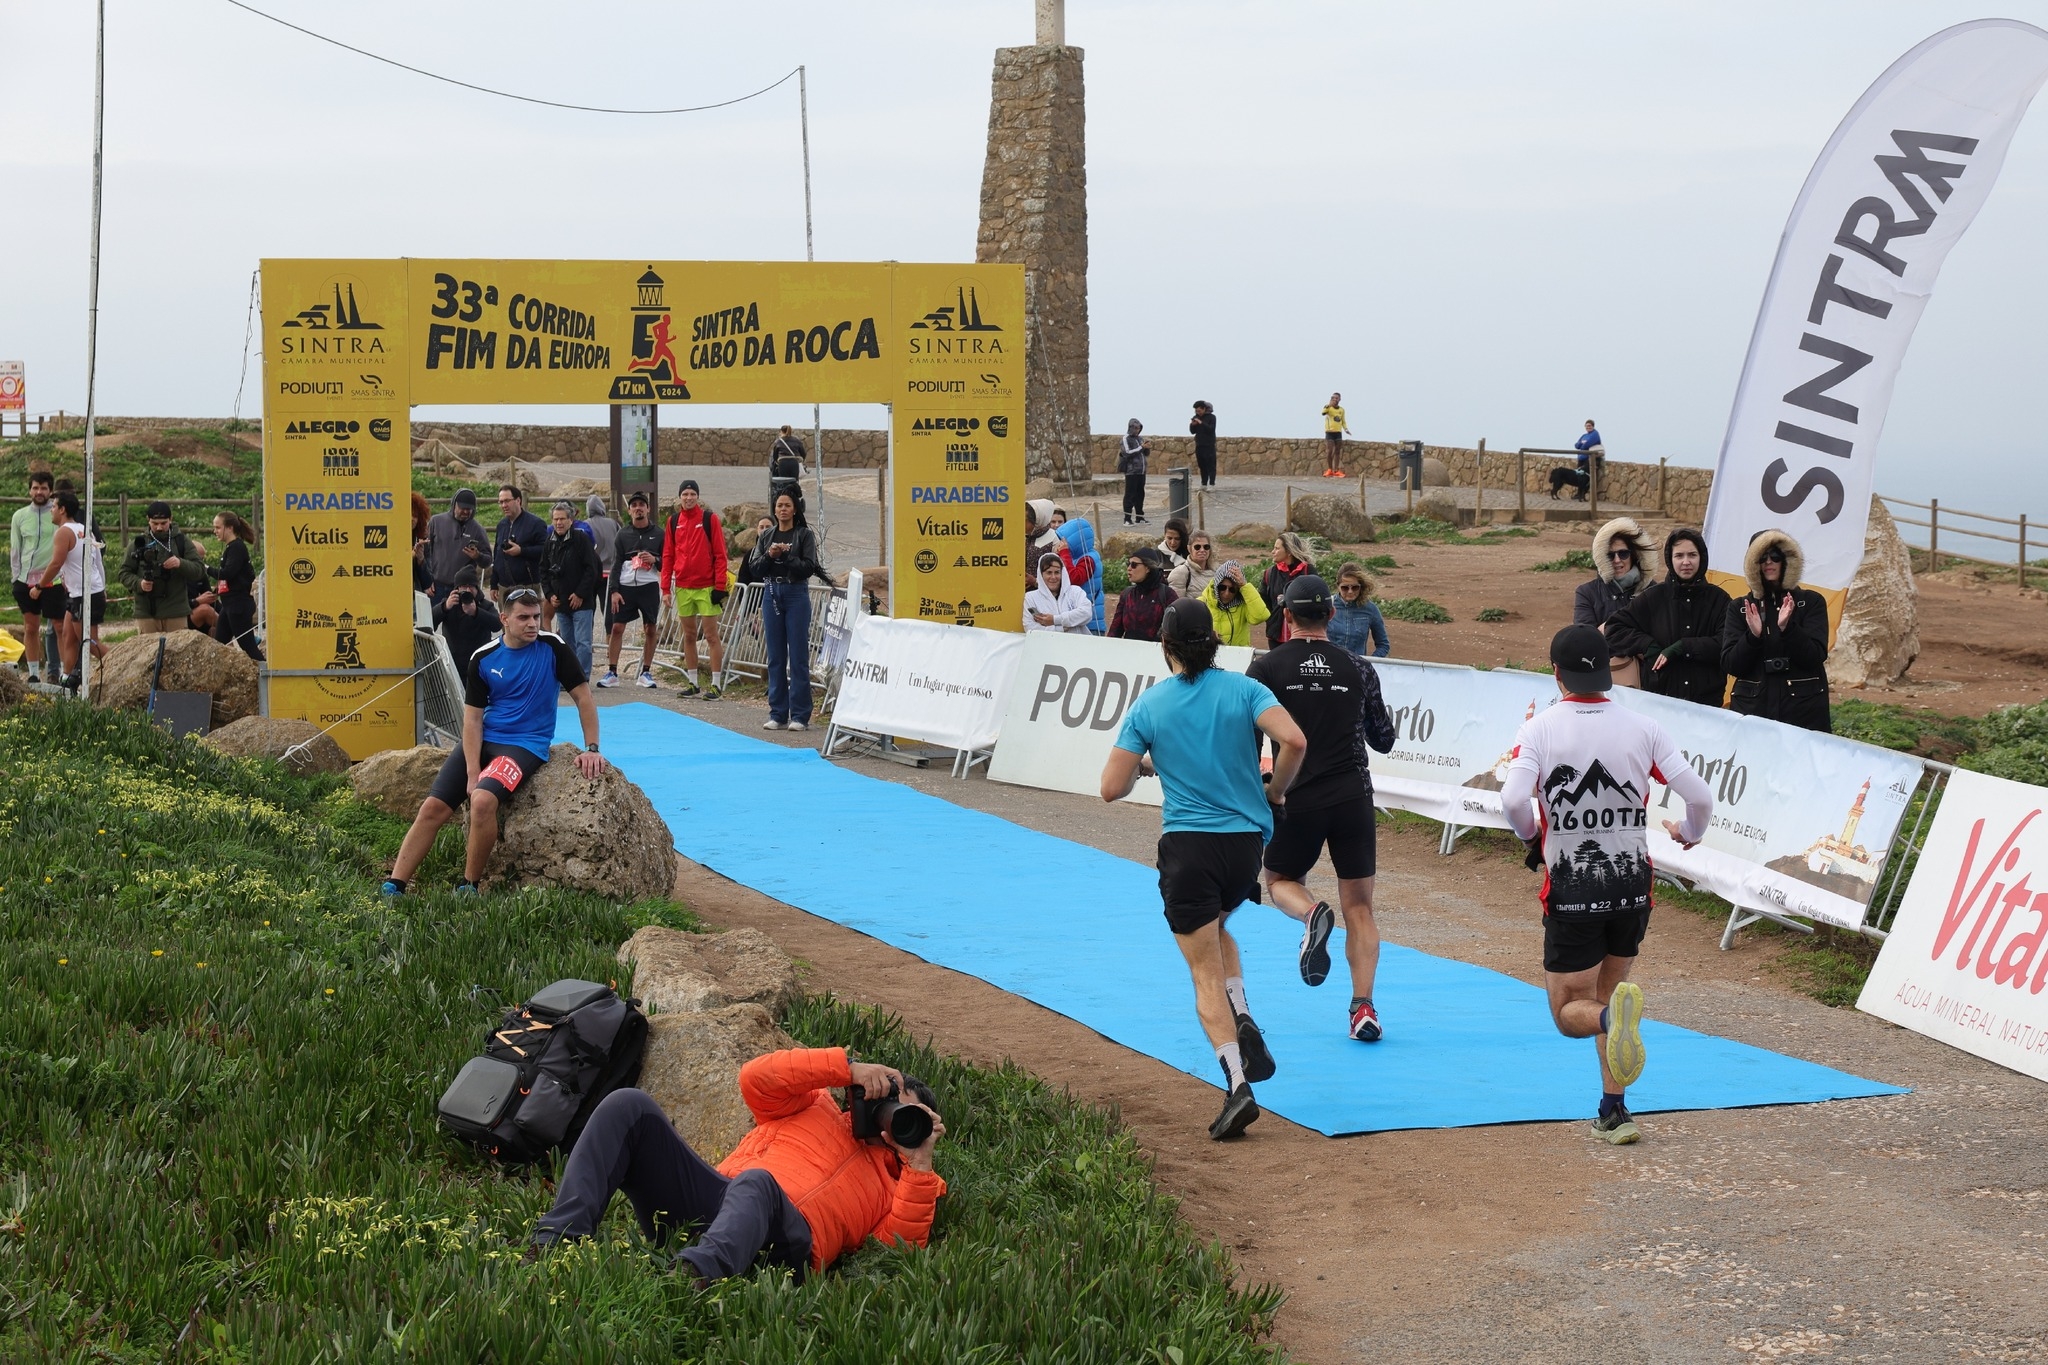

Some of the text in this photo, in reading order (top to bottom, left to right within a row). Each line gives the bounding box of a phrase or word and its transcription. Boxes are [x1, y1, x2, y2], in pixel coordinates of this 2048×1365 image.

[508, 293, 597, 341] CORRIDA
[692, 302, 760, 342] SINTRA
[281, 337, 385, 354] SINTRA
[426, 323, 611, 370] FIM DA EUROPA
[690, 317, 880, 370] CABO DA ROCA
[909, 338, 1003, 354] SINTRA
[280, 382, 343, 394] PODIUM
[618, 381, 646, 395] 17 KM
[661, 388, 681, 396] 2024
[908, 381, 965, 392] PODIUM
[990, 388, 1012, 396] SINTRA
[372, 390, 396, 398] SINTRA
[284, 420, 360, 434] ALEGRO
[911, 418, 980, 430] ALEGRO
[323, 447, 359, 456] 100%
[946, 443, 979, 451] 100%
[323, 467, 359, 476] FITCLUB
[945, 463, 979, 472] FITCLUB
[285, 490, 394, 510] PARABÉNS
[911, 484, 1010, 504] PARABÉNS
[916, 515, 969, 536] Vitalis
[983, 521, 1002, 538] illy
[291, 523, 349, 545] Vitalis
[365, 529, 386, 547] illy
[971, 555, 1008, 567] BERG
[353, 565, 394, 577] BERG
[919, 607, 934, 616] FIM
[935, 608, 943, 616] DA
[295, 619, 311, 628] FIM
[313, 620, 321, 628] DA
[371, 617, 388, 625] ROCA
[336, 676, 357, 684] 2024
[923, 675, 945, 695] lugar
[945, 683, 961, 697] que
[1029, 663, 1156, 731] PODI
[1387, 749, 1461, 768] CORRIDA FIM DA EUROPA
[1894, 977, 1933, 1012] ÁGUA
[1932, 995, 1997, 1036] MINERAL
